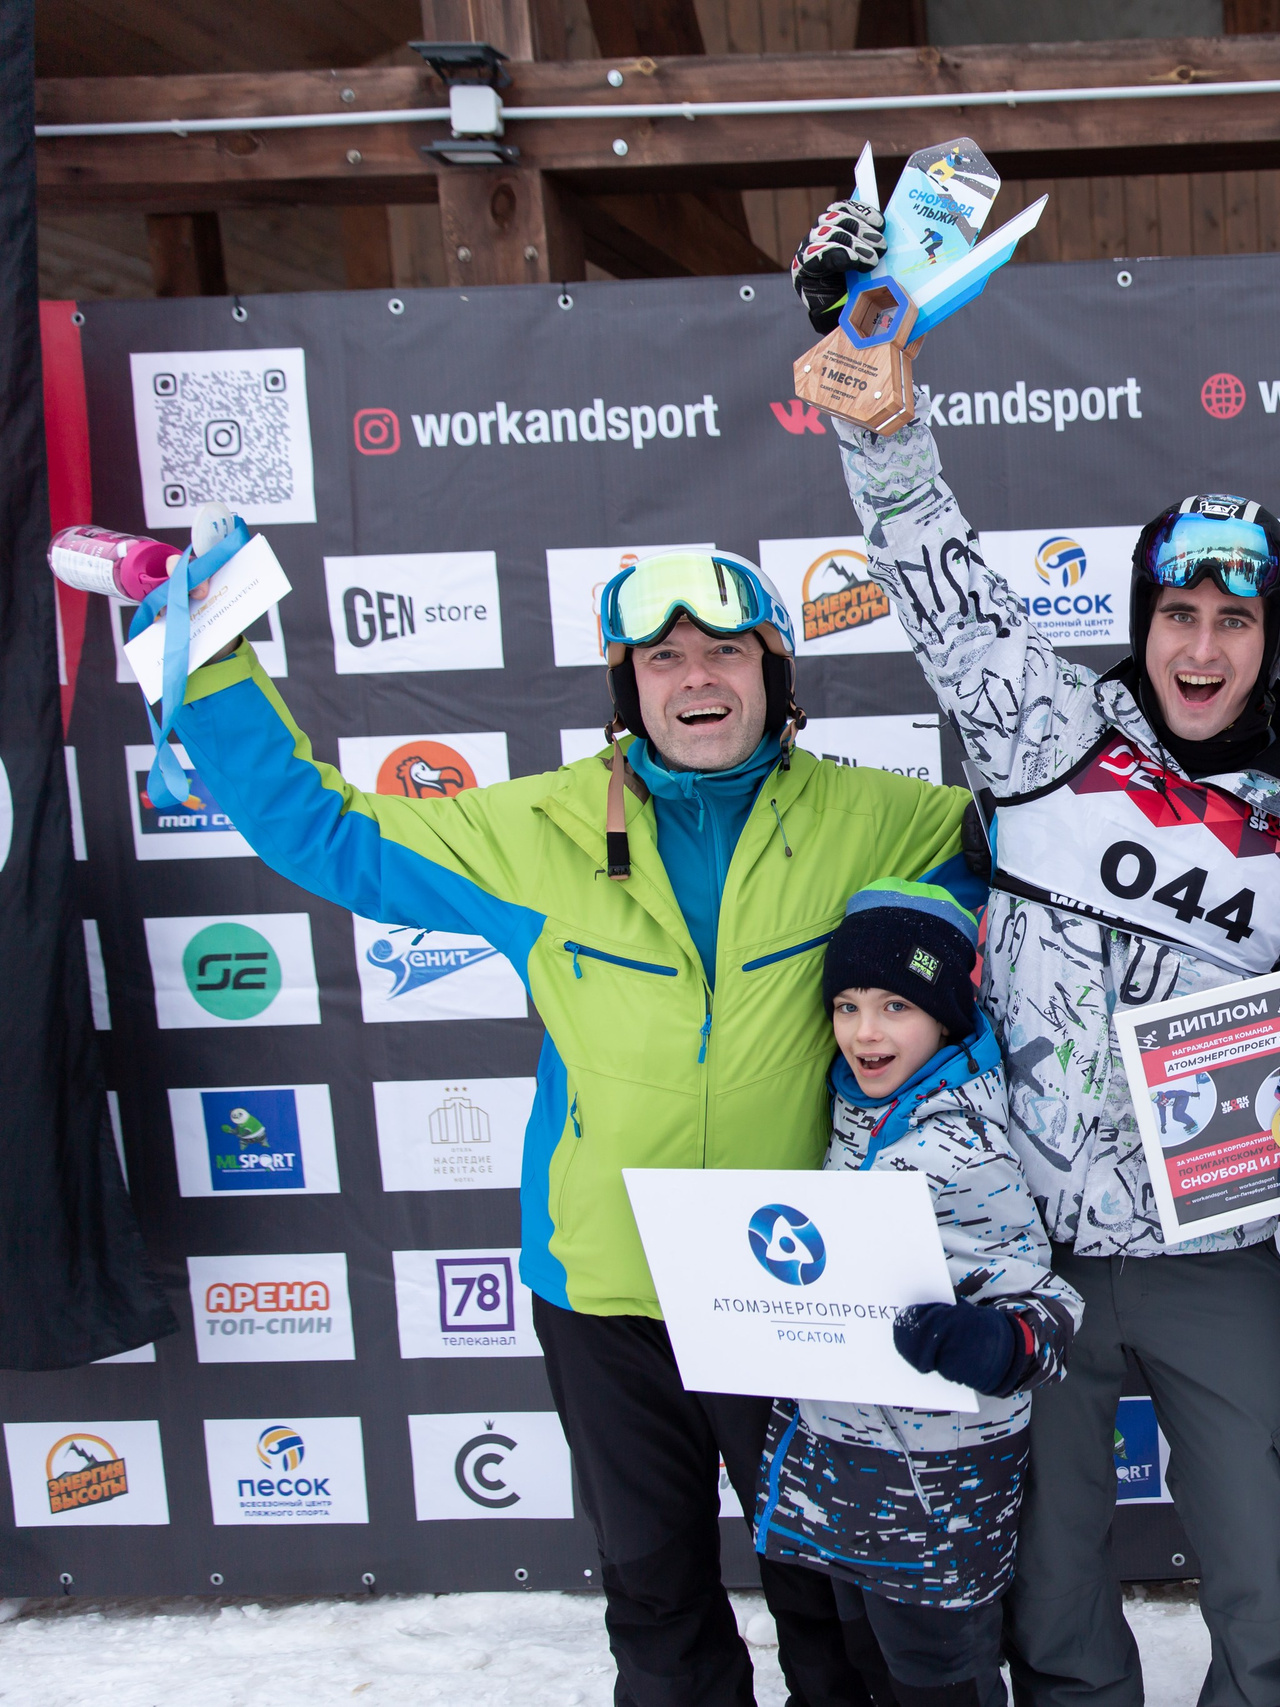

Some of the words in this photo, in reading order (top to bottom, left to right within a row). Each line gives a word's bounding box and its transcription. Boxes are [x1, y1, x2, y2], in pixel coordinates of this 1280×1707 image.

[908, 188, 975, 218] СНОУБОРД
[917, 205, 959, 227] ЛЫЖИ
[820, 366, 827, 377] 1
[827, 369, 868, 391] МЕСТО
[411, 395, 721, 450] workandsport
[342, 586, 417, 648] GEN
[424, 601, 488, 623] store
[804, 596, 890, 640] ВЫСОТЫ
[1084, 619, 1114, 627] ЦЕНТР
[1073, 629, 1110, 638] СПОРТА
[1100, 840, 1256, 945] 044
[1167, 999, 1268, 1040] ДИПЛОМ
[1167, 1036, 1277, 1073] АТОМЭНЕРГОПРОЕКТ
[1172, 1035, 1233, 1056] НАГРАЖДАЕТСЯ
[1234, 1024, 1274, 1042] КОМАНДА
[433, 1155, 492, 1165] НАСЛЕДИЕ
[433, 1165, 494, 1175] HERITAGE
[1178, 1167, 1193, 1177] ПО
[1195, 1145, 1265, 1172] ГИГАНТСКОМУ
[1186, 1150, 1217, 1164] УЧАСТИЕ
[1180, 1163, 1258, 1189] СНОУБОРД
[1260, 1157, 1271, 1168] И
[1191, 1189, 1229, 1204] workandsport
[1238, 1175, 1276, 1190] workandsport
[206, 1281, 330, 1313] АРЕНА
[451, 1273, 501, 1317] 78
[713, 1298, 901, 1320] АТОМЭНЕРГОПРОЕКТ
[206, 1317, 332, 1336] ТОП-СПИН
[777, 1329, 846, 1344] РОСАТОМ
[441, 1336, 517, 1347] телеканал
[48, 1459, 125, 1495] ЭНЕРГИЯ
[50, 1476, 128, 1514] ВЫСОТЫ
[239, 1500, 303, 1508] ВСЕСЕЗОННЫЙ
[305, 1500, 332, 1508] ЦЕНТР
[296, 1509, 331, 1517] СПОРТА
